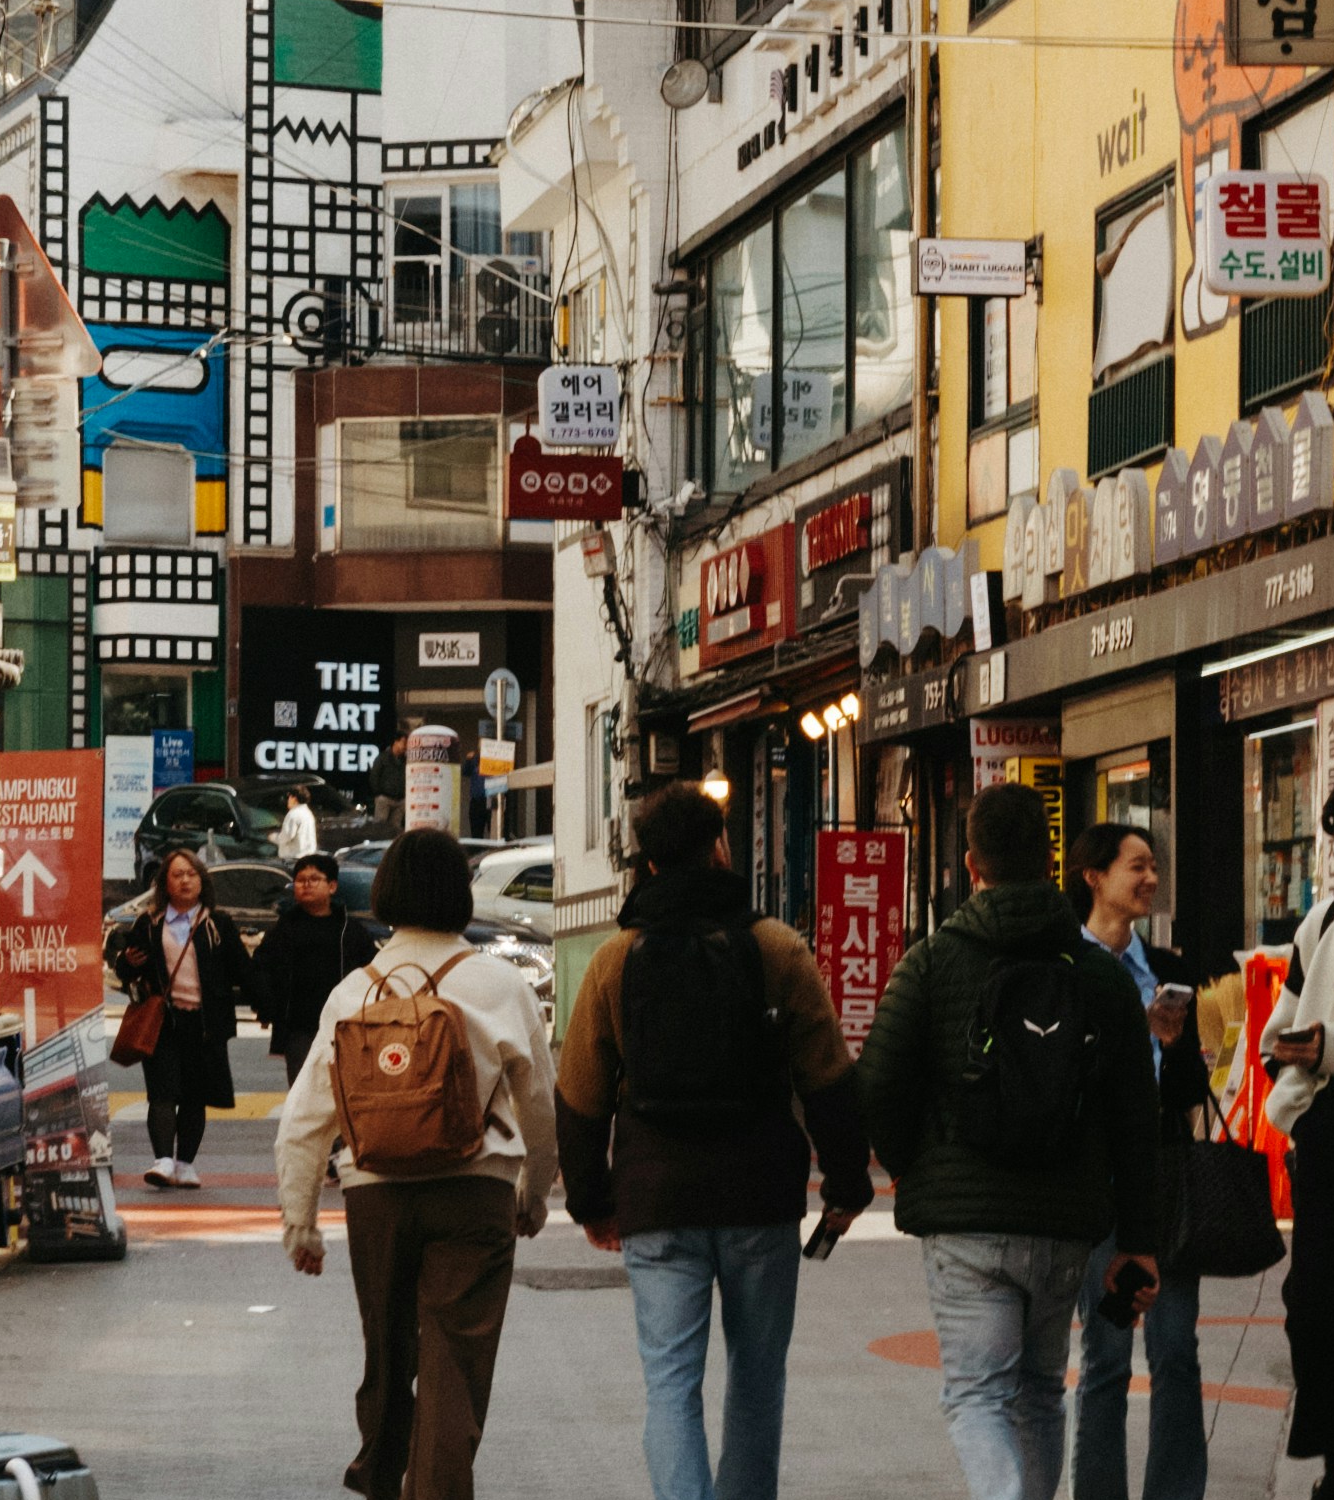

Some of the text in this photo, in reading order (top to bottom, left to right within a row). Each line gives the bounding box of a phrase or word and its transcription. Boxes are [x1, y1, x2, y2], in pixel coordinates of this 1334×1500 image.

[1097, 88, 1147, 178] wait
[1219, 182, 1321, 239] 철물
[949, 264, 1024, 272] SMART LUGGAGE
[561, 374, 602, 396] 헤어
[551, 401, 614, 423] 갤러리
[315, 661, 380, 692] THE
[313, 702, 381, 731] ART
[162, 736, 184, 748] Live
[254, 740, 380, 772] CENTER
[32, 925, 68, 949] WAY
[10, 949, 78, 973] METRES
